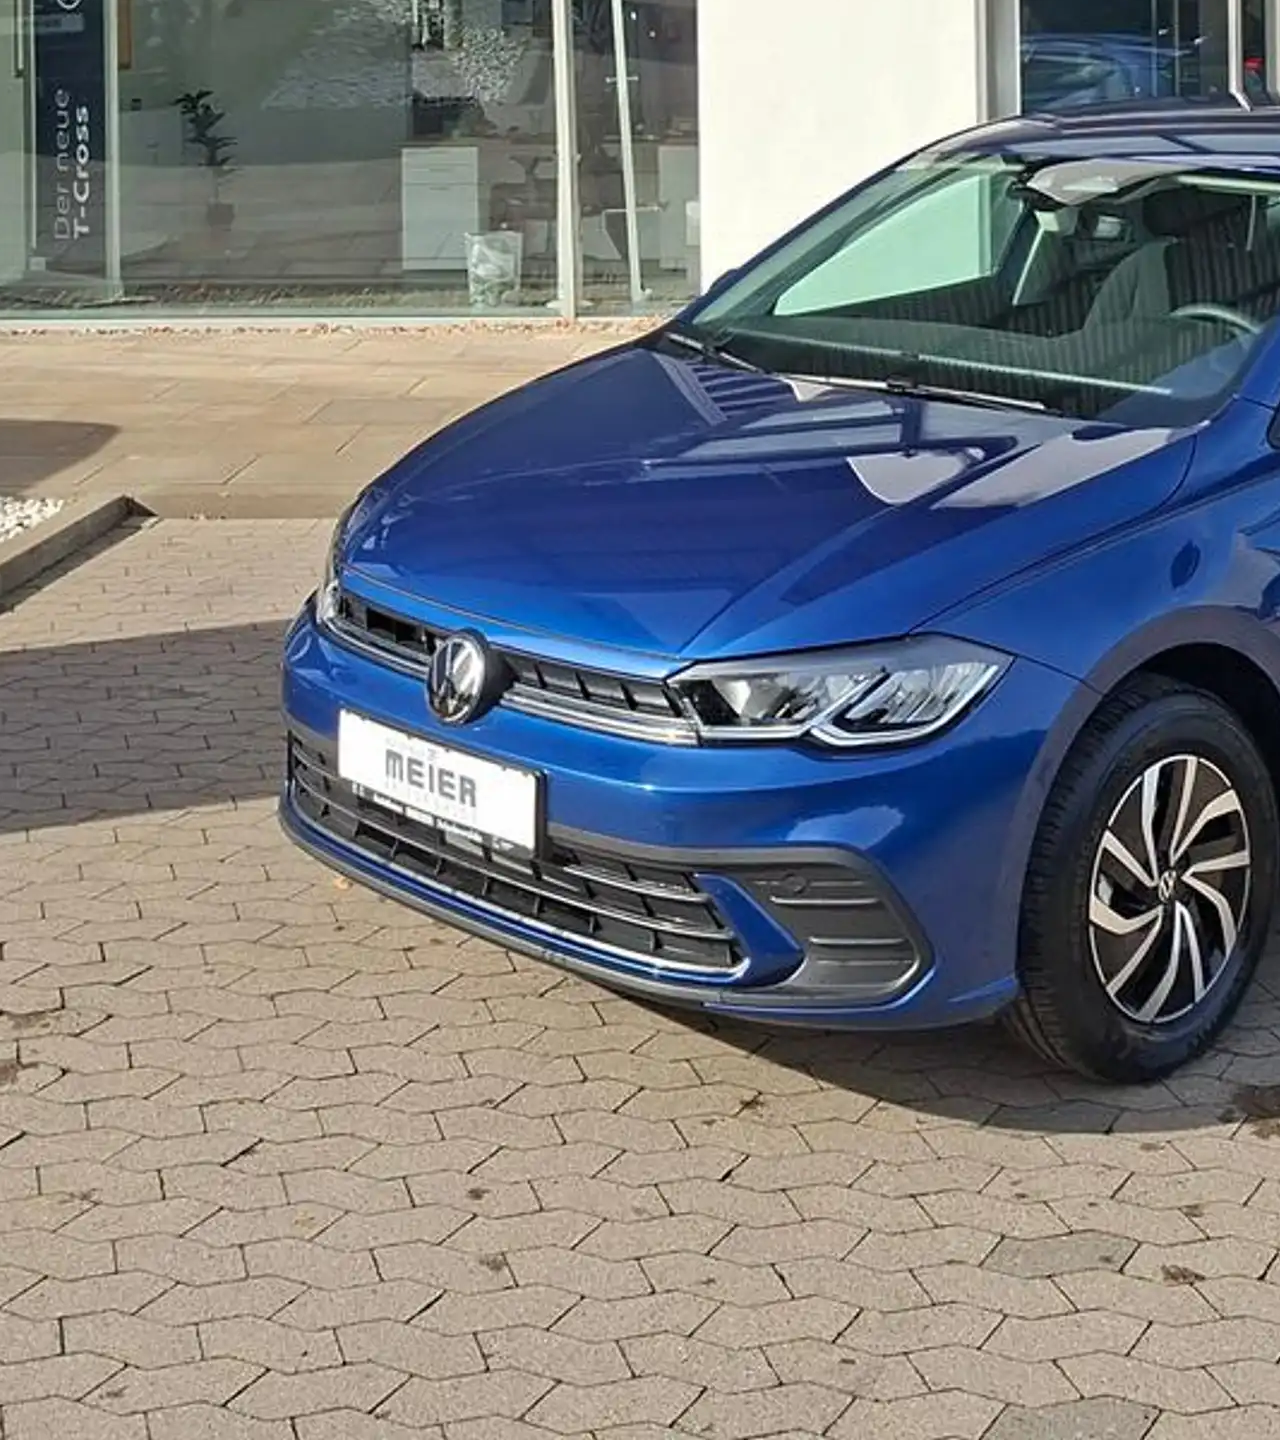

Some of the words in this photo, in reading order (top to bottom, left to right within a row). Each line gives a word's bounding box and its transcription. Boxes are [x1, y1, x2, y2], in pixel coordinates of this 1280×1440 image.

[54, 89, 70, 174] neue
[74, 105, 90, 240] T-Cross
[54, 181, 70, 242] Der
[385, 749, 477, 807] MEIER
